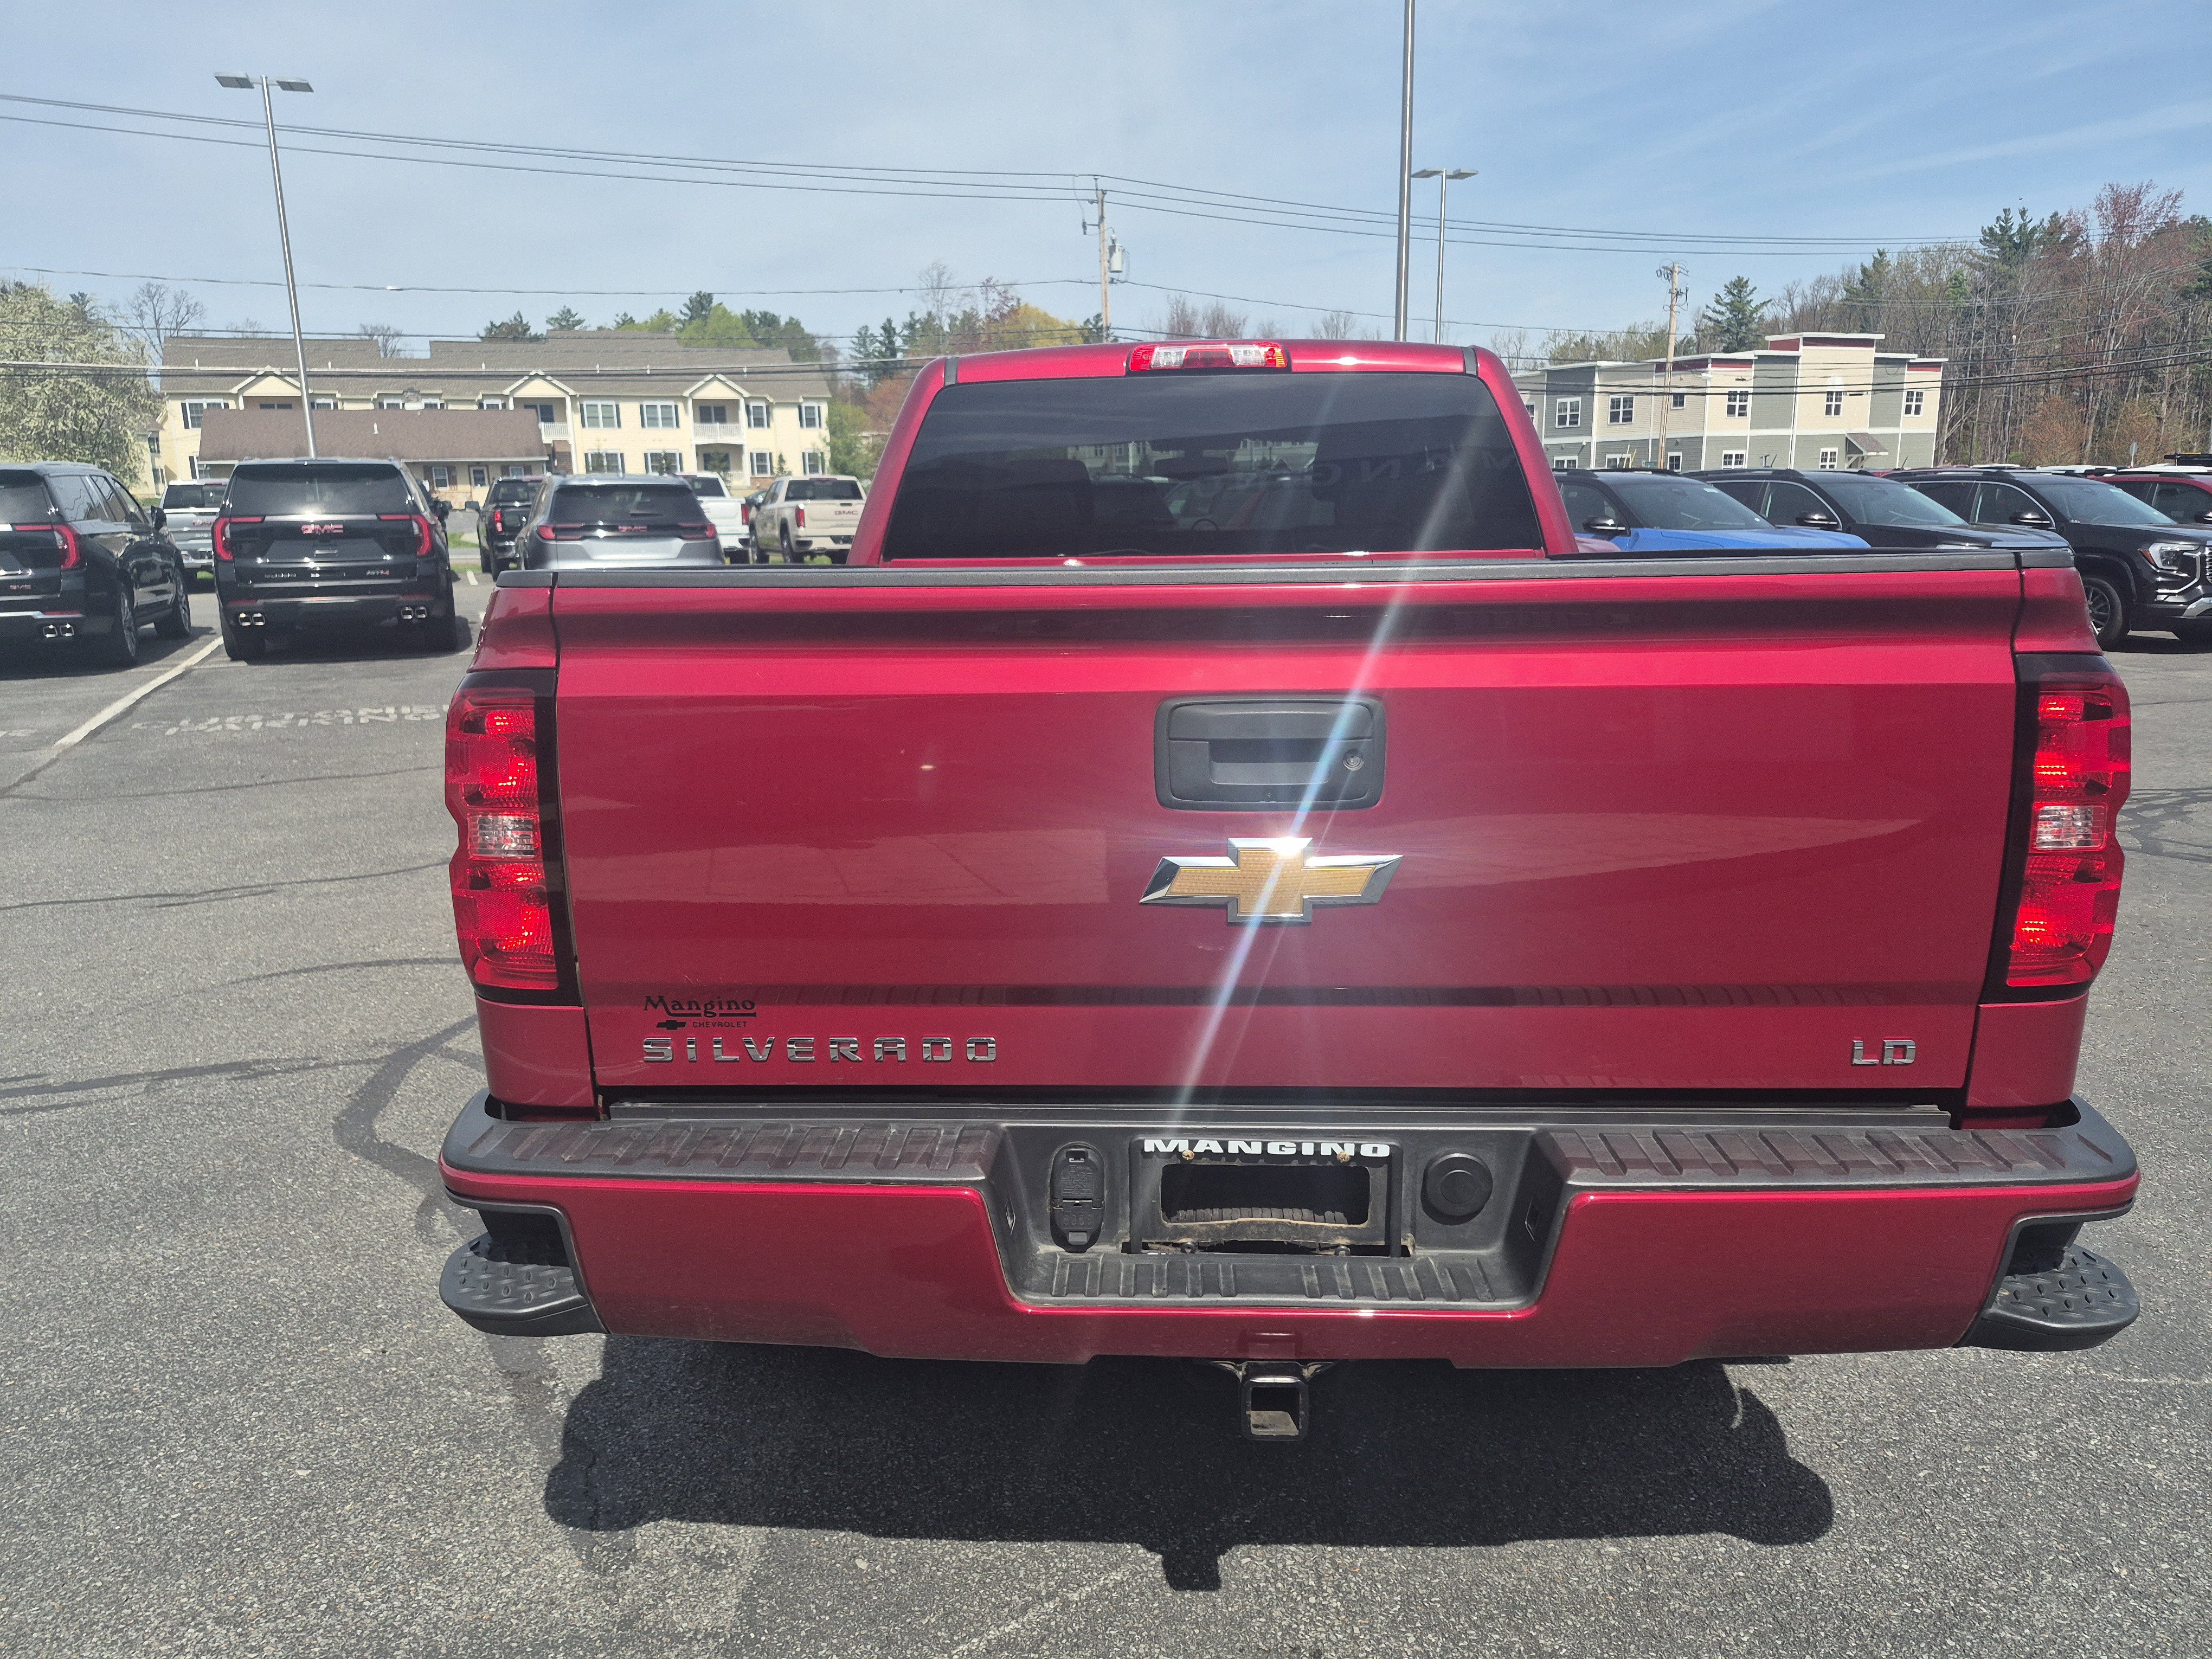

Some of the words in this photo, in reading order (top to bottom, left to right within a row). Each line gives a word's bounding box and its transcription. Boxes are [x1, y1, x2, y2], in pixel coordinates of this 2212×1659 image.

[301, 524, 344, 534] GMC
[644, 996, 756, 1018] Mangino
[643, 1037, 996, 1062] SILVERADO
[1852, 1039, 1915, 1065] LD
[1144, 1139, 1390, 1157] MANGINO
